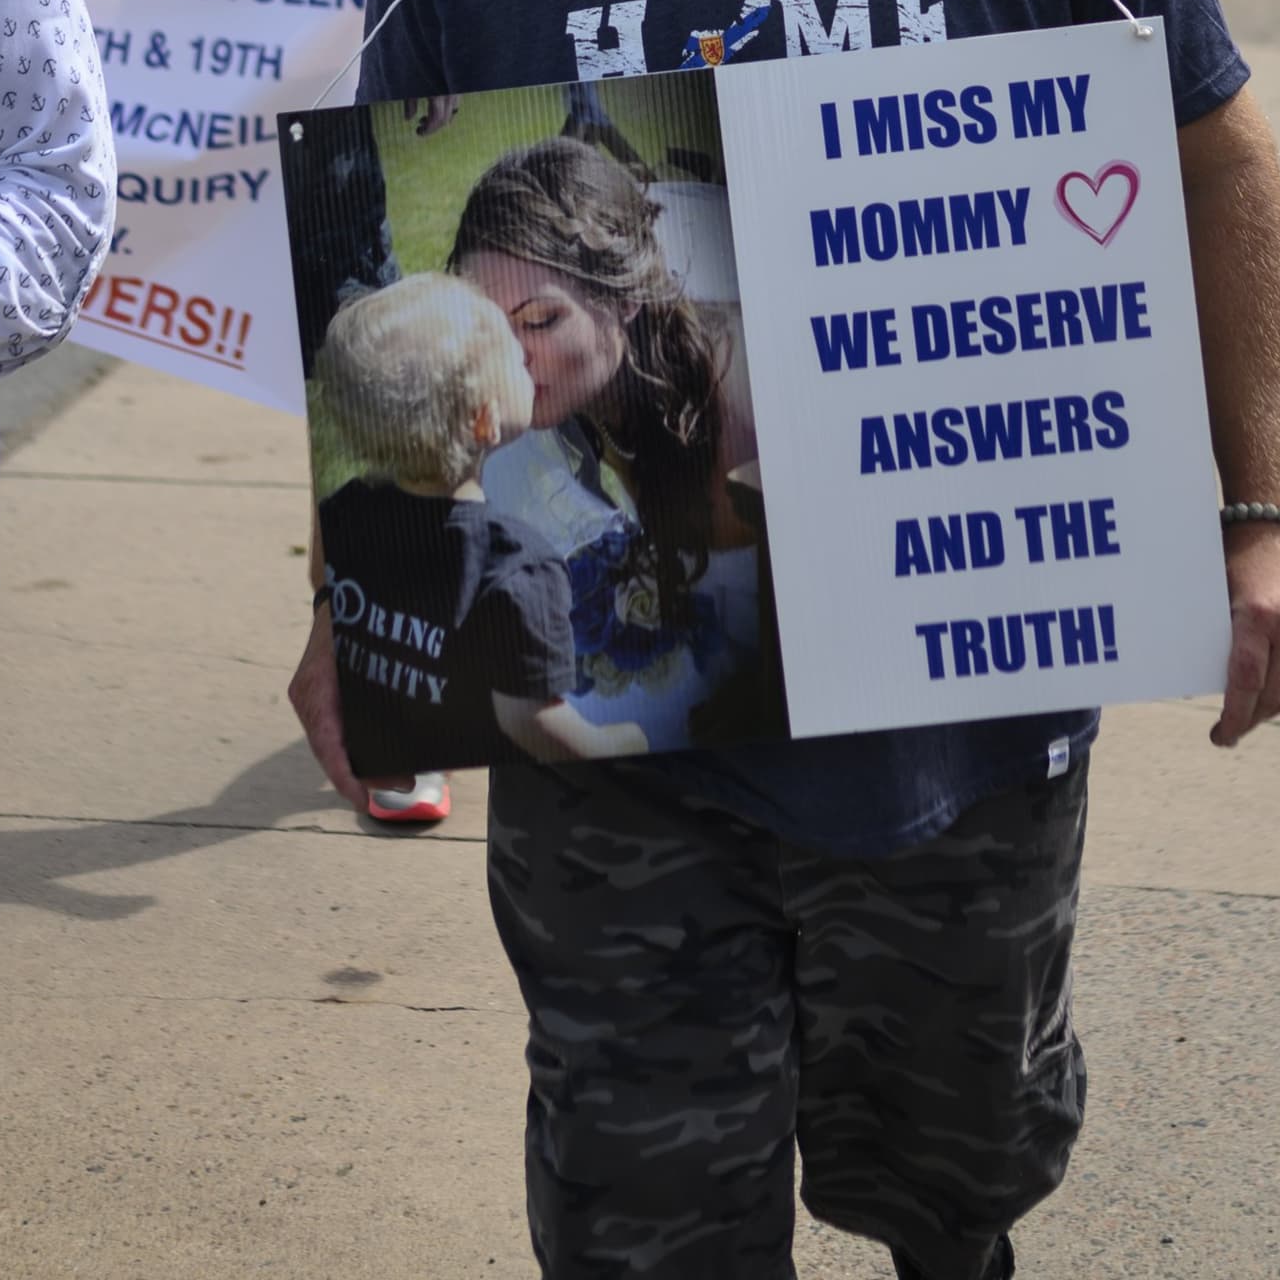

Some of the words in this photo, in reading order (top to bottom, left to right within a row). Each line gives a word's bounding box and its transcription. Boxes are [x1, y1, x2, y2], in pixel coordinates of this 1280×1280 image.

[144, 30, 172, 69] &
[189, 35, 283, 81] 19TH
[820, 102, 842, 160] I
[852, 85, 998, 157] MISS
[1008, 73, 1091, 139] MY
[809, 187, 1031, 268] MOMMY
[809, 304, 902, 373] WE
[911, 281, 1152, 363] DESERVE
[860, 390, 1130, 475] ANSWERS
[894, 511, 1006, 578] AND
[1014, 497, 1121, 564] THE
[914, 604, 1119, 681] TRUTH!
